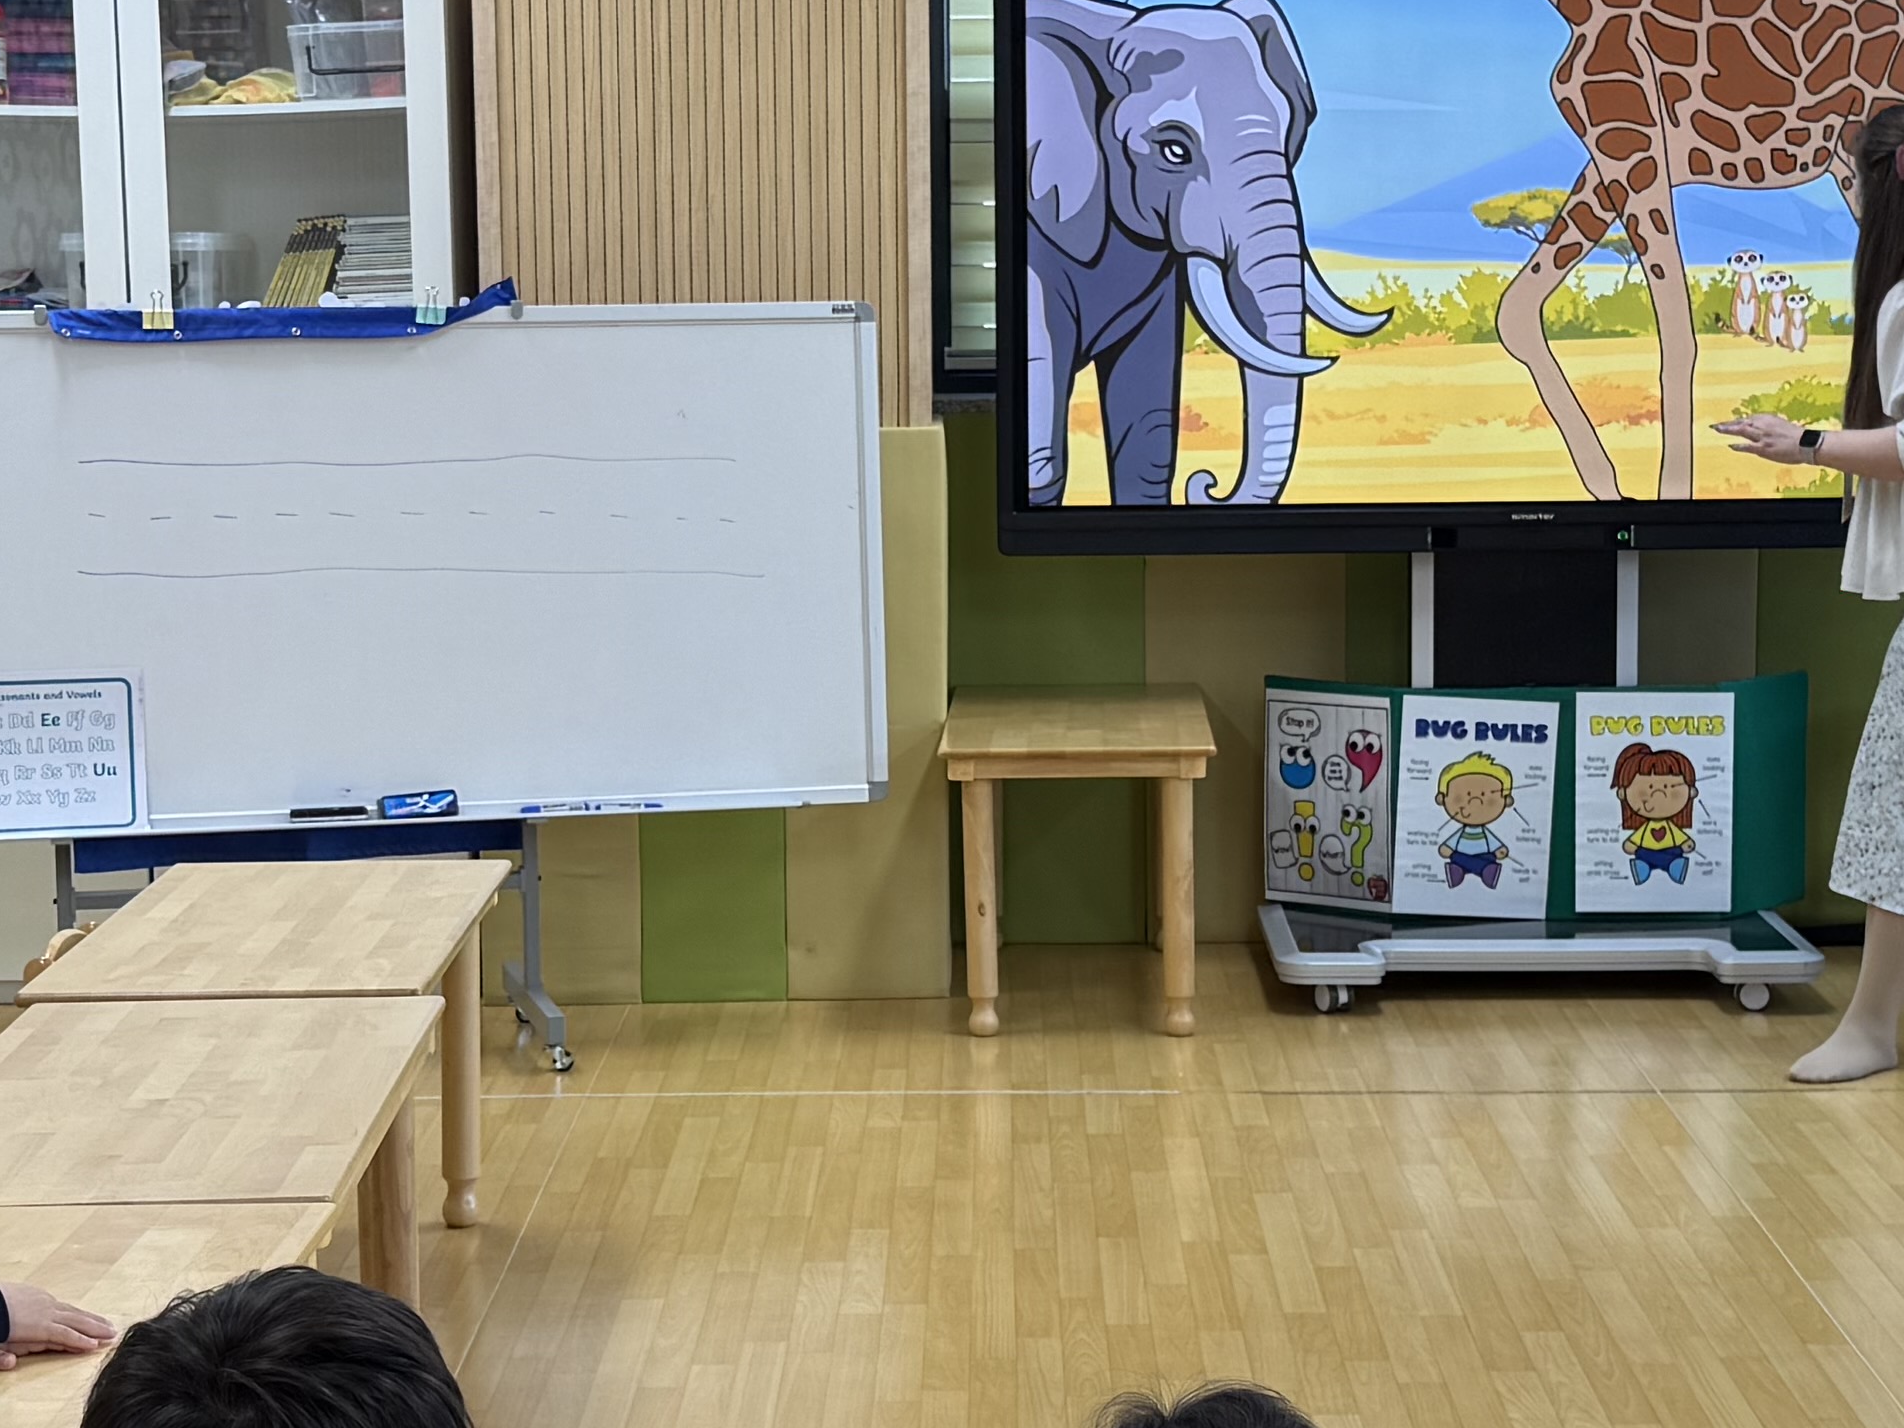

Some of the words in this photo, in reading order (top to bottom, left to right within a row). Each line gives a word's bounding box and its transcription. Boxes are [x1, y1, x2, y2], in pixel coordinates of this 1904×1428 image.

[44, 691, 63, 699] and
[66, 690, 102, 699] Vowels
[41, 713, 60, 726] Ee
[1590, 716, 1644, 736] RUG
[1650, 716, 1725, 736] RULES
[1415, 718, 1468, 740] RUG
[1475, 722, 1548, 744] RULES
[93, 763, 117, 776] Uu
